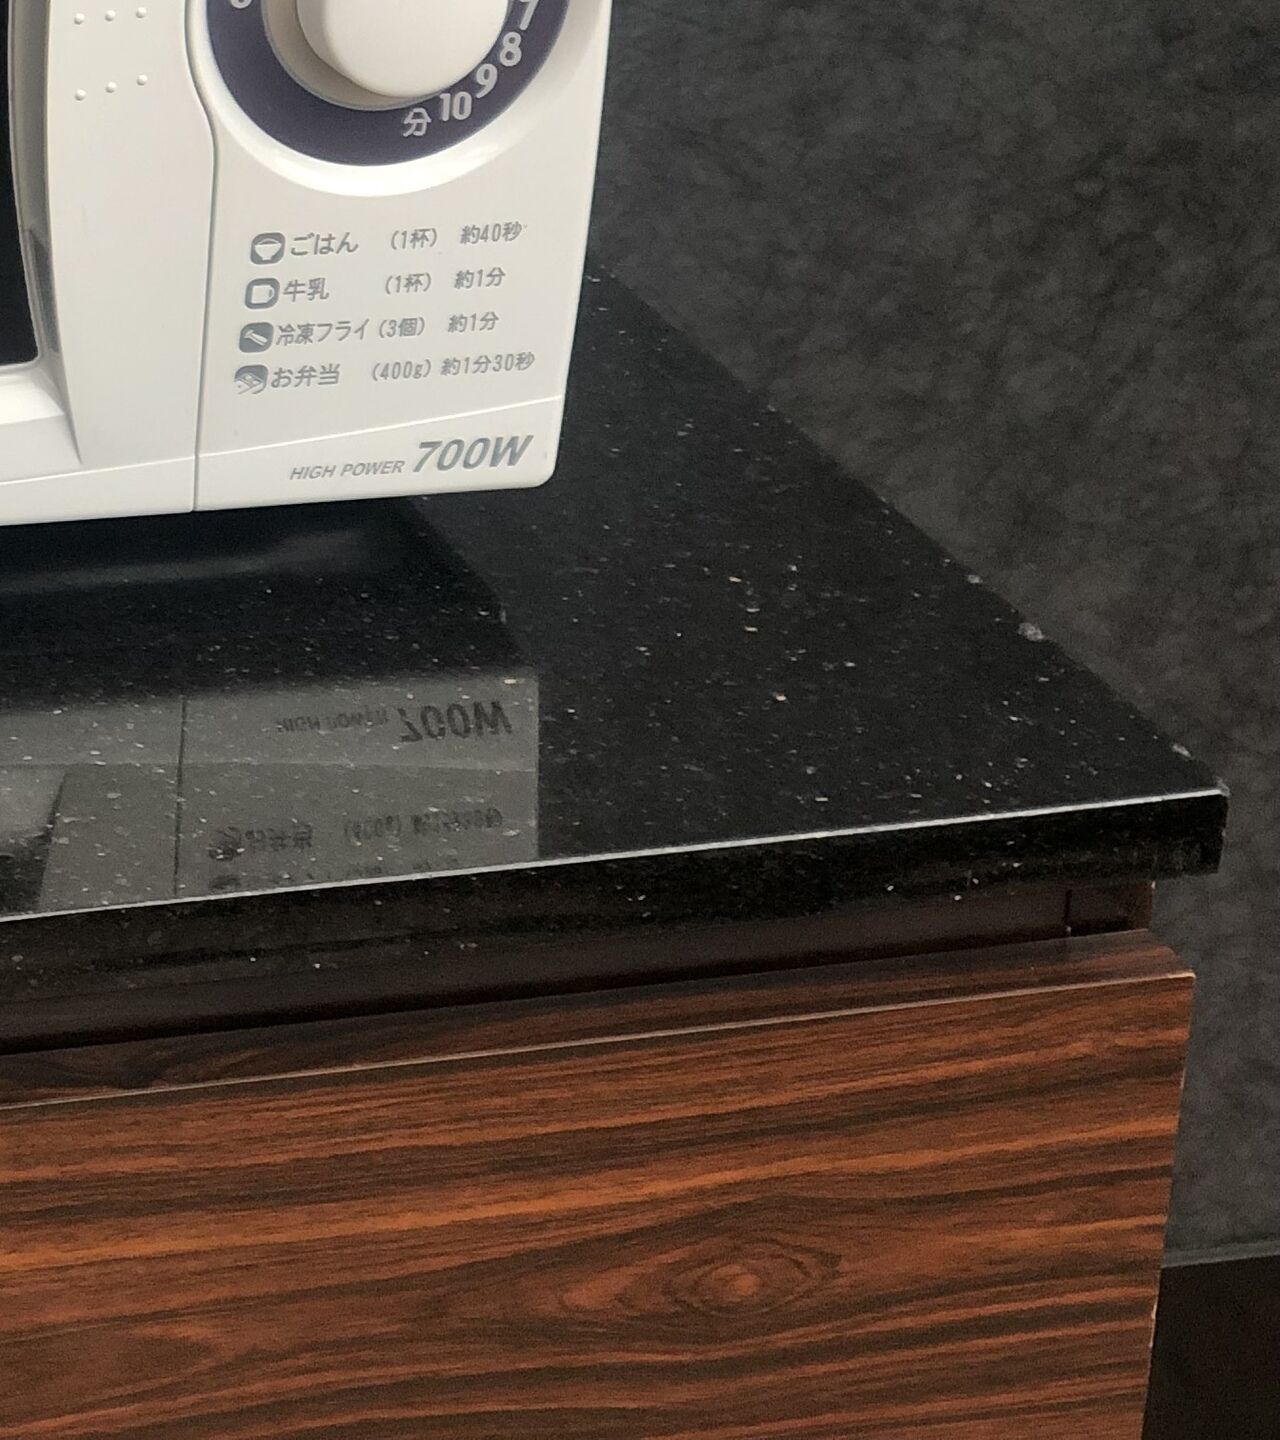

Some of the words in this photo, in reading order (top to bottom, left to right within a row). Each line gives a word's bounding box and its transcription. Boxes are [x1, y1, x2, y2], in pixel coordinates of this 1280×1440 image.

[499, 32, 522, 67] 8
[475, 63, 498, 99] 9
[402, 107, 432, 137] 分
[440, 92, 472, 122] 10
[290, 231, 359, 256] ごはん
[390, 227, 438, 250] （1杯）
[459, 221, 523, 245] 約40秒
[282, 277, 330, 303] 牛乳
[385, 272, 432, 295] （1杯）
[453, 266, 506, 290] 約1分
[275, 318, 371, 347] 冷凍フライ
[378, 316, 425, 339] （3個）
[447, 311, 500, 333] 約1分
[270, 363, 341, 389] お弁当
[440, 351, 536, 376] 約1分30秒
[289, 464, 336, 481] HIGH
[340, 459, 406, 477] POWER
[413, 434, 534, 473] 700W
